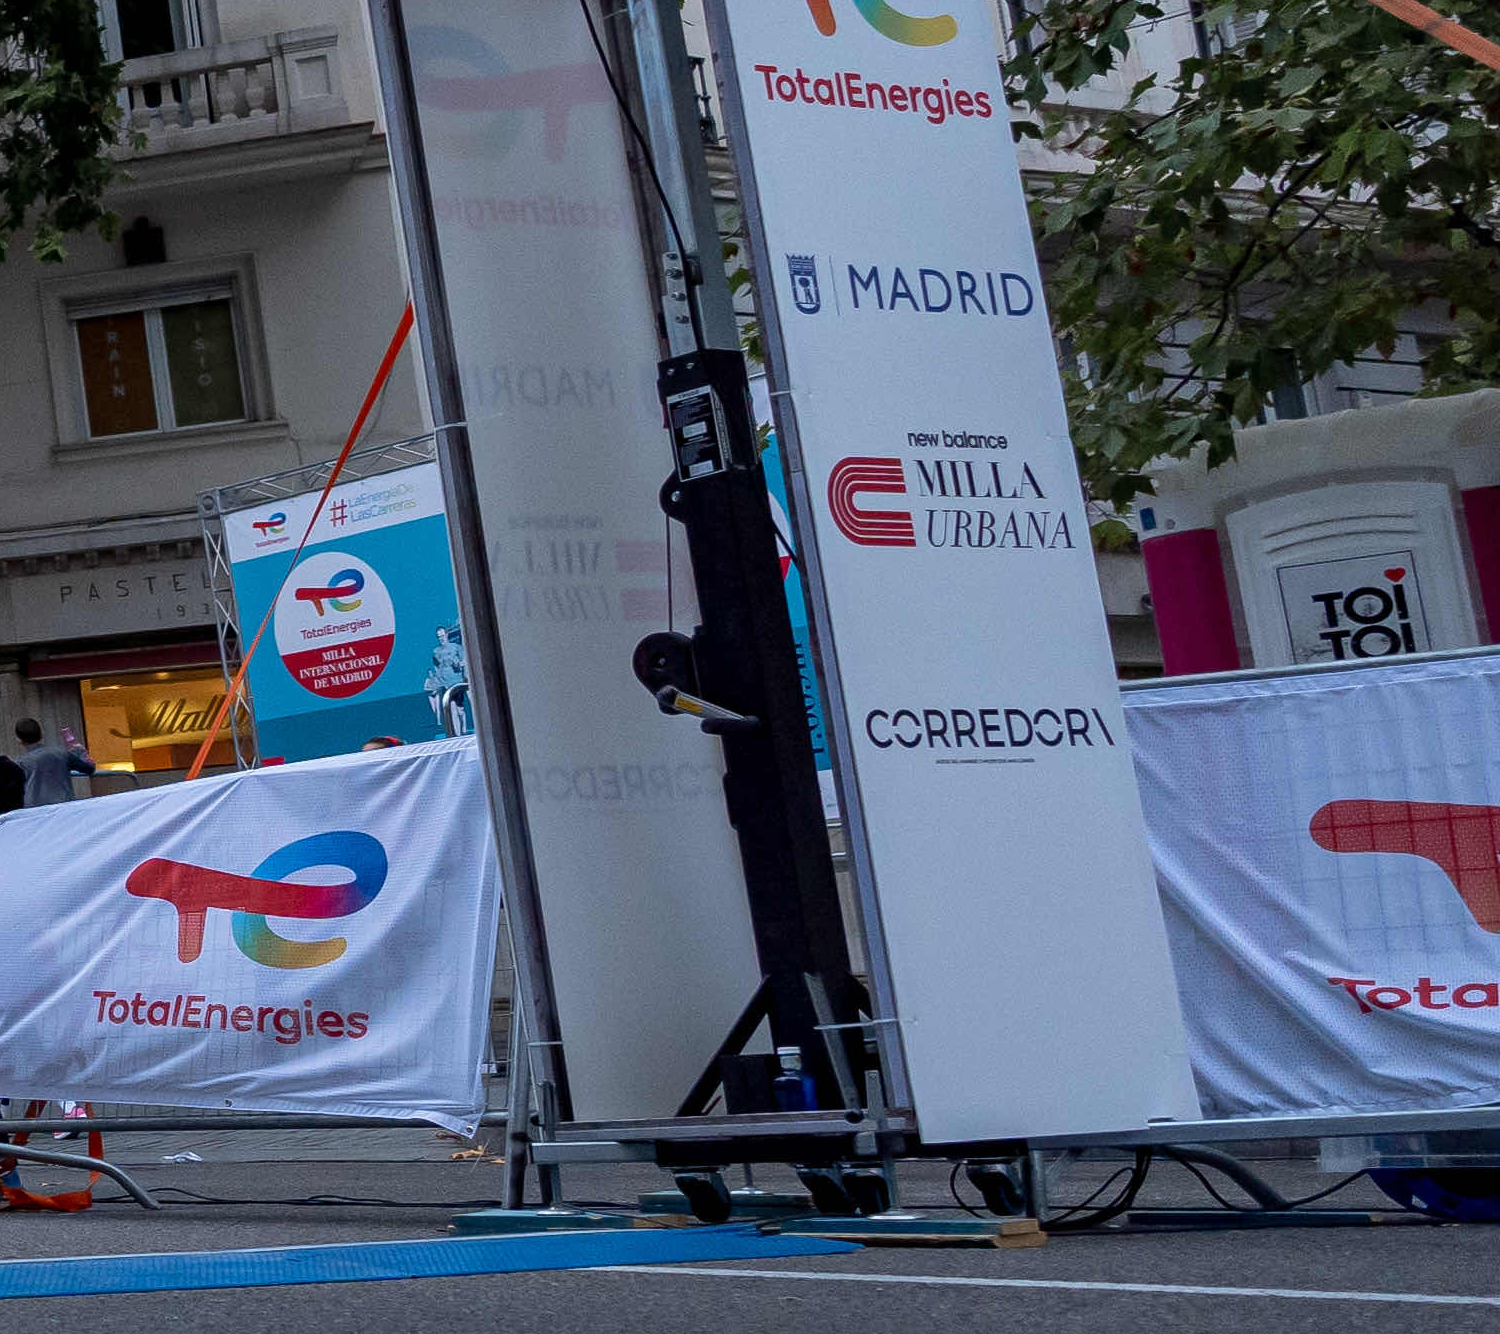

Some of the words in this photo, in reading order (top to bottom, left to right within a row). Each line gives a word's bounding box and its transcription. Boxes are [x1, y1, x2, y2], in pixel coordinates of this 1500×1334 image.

[754, 63, 993, 126] TotalEnergies
[849, 265, 1034, 318] MADRID
[908, 432, 939, 447] new
[942, 430, 1008, 450] balance
[912, 459, 1047, 499] MILLA
[925, 509, 1076, 549] URBANA
[300, 618, 371, 640] TotalEnergies
[322, 646, 356, 662] MILLA
[314, 679, 329, 689] DE
[331, 670, 372, 686] MADRID
[93, 990, 369, 1045] TotalEnergies
